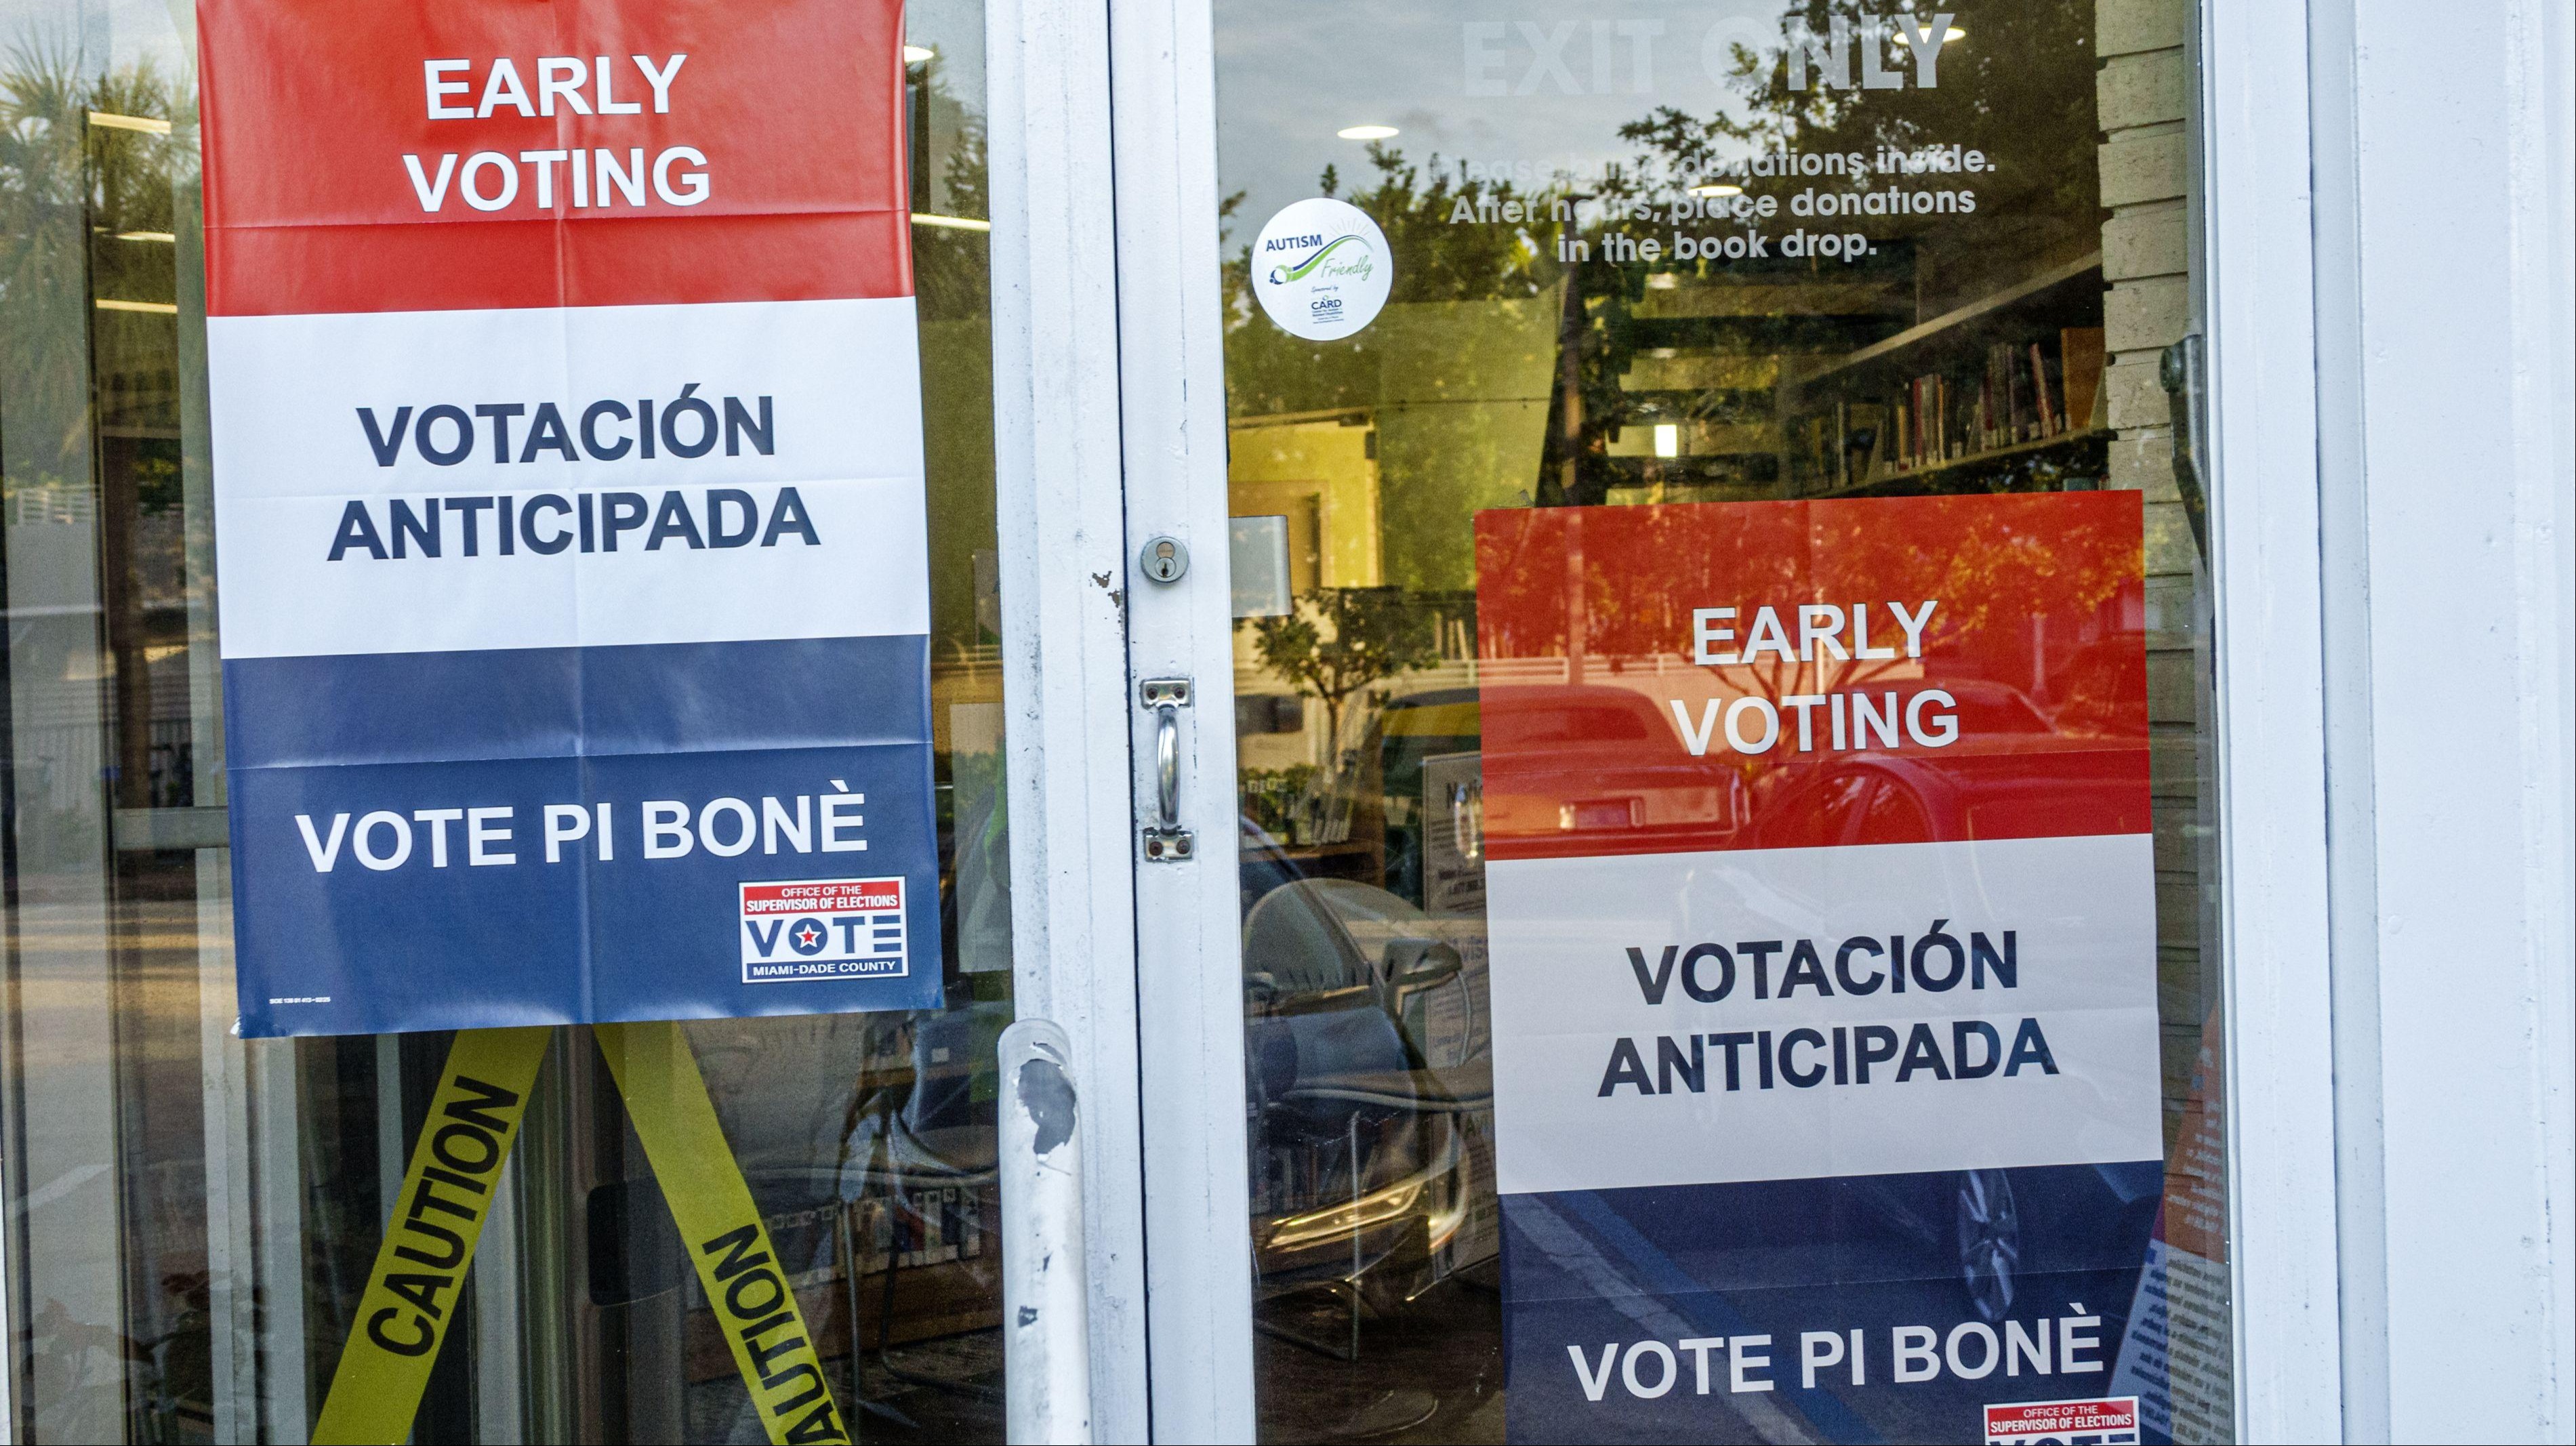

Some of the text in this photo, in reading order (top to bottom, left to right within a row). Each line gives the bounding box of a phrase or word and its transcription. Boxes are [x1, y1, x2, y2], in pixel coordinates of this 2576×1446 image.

[424, 54, 687, 119] EARLY
[1463, 13, 1955, 98] EXIT ONLY
[402, 145, 710, 212] VOTING
[1679, 147, 1865, 178] donations
[1876, 144, 1996, 174] inside.
[1449, 186, 1977, 226] After hours, place donations
[1266, 234, 1322, 251] AUTISM
[1320, 255, 1374, 281] Friendly
[1557, 228, 1877, 263] in the book drop.
[1311, 299, 1342, 310] CARD
[356, 383, 775, 467] VOTACIÓN
[327, 487, 821, 561] ANTICIPADA
[1692, 600, 1939, 665] EARLY
[1669, 689, 1959, 756] VOTING
[295, 780, 868, 873] VOTE PI BONÈ
[746, 894, 898, 912] SUPERVISOR OF ELECTIONS
[781, 885, 861, 898] OFFICE OF THE
[745, 915, 902, 957] VOTE
[753, 961, 896, 976] MIAMI-DADE COUNTY
[1625, 919, 2018, 1006] VOTACIÓN
[1597, 1018, 2060, 1097] ANTICIPADA
[367, 1074, 519, 1357] CAUTION
[702, 1224, 846, 1445] AUTION
[1566, 1302, 2104, 1402] VOTE PI BONÈ
[1990, 1413, 2132, 1434] SUPERVISOR OF ELECTIONS
[2023, 1405, 2098, 1418] OFFICE OF THE
